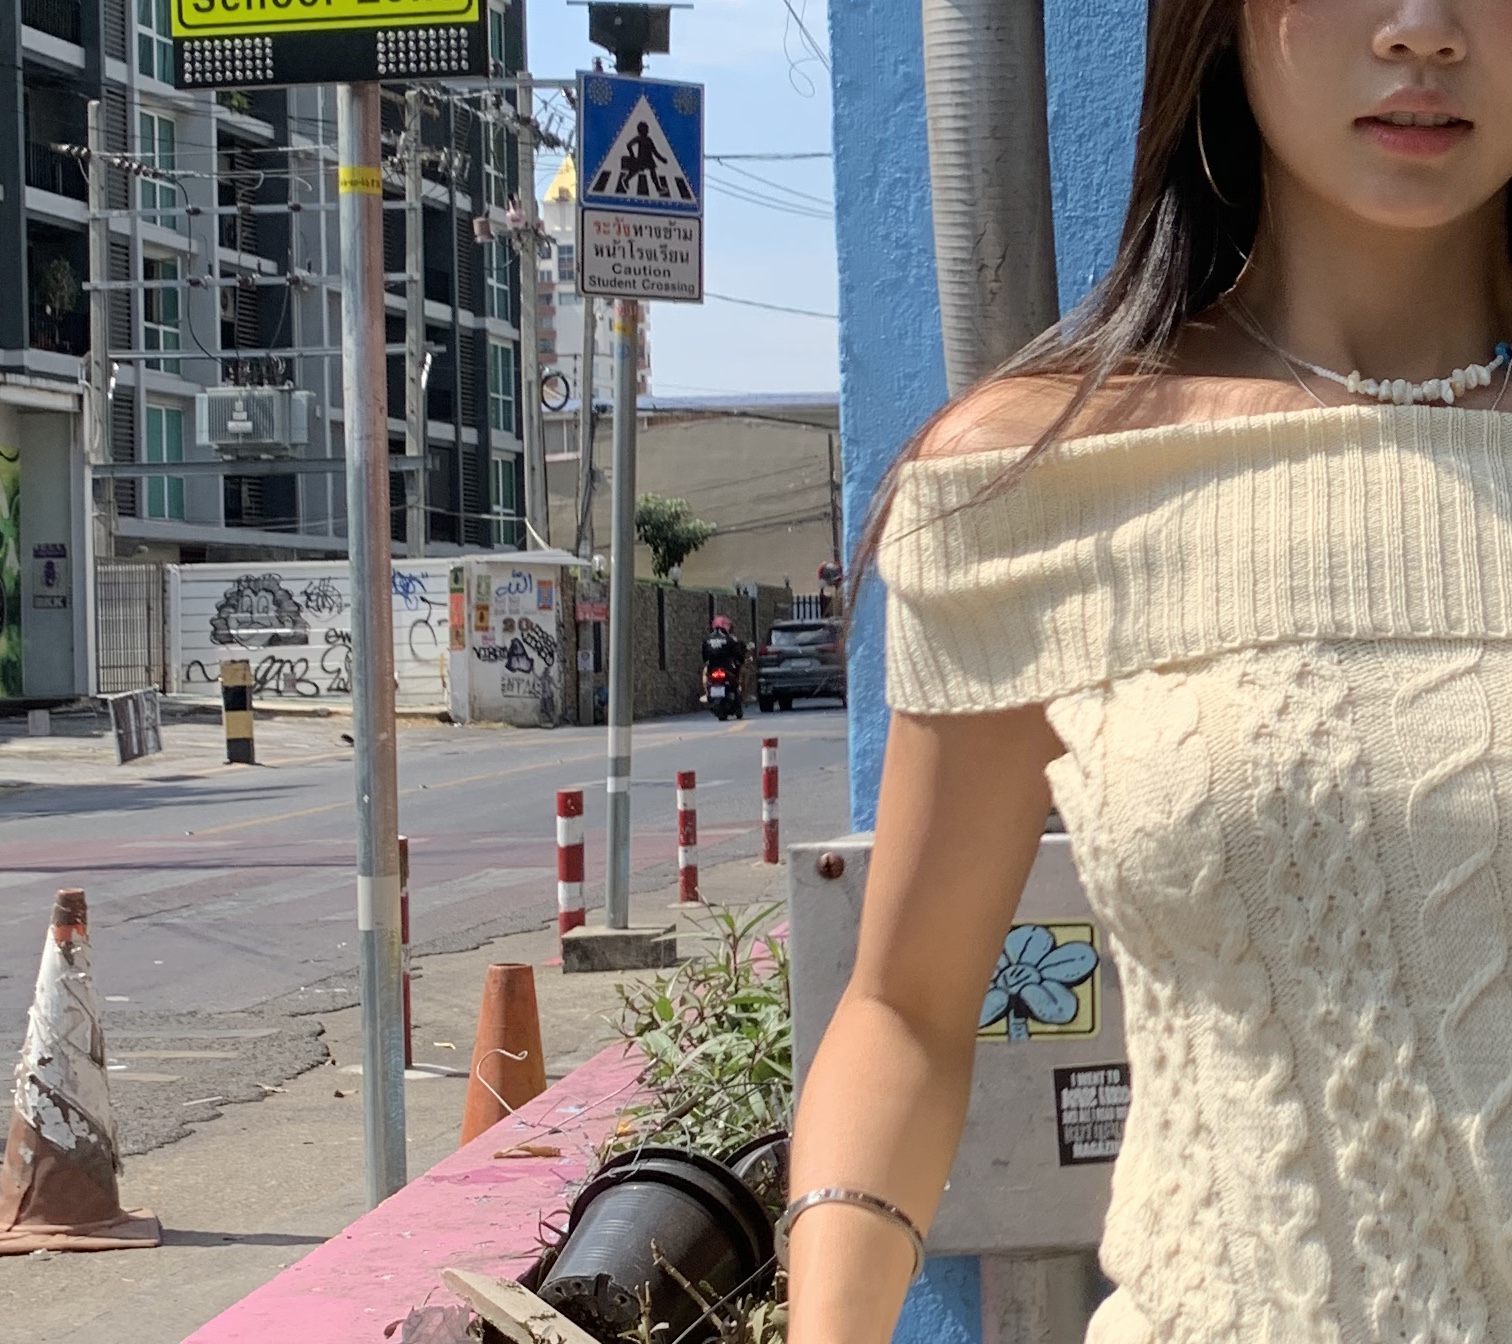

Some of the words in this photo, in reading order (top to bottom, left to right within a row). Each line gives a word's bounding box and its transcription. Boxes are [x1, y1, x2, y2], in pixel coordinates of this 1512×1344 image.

[594, 217, 692, 242] ระวังทางข้าม
[594, 239, 690, 264] หน้าโรงเรียน
[612, 263, 671, 279] Caution
[588, 274, 637, 291] Student
[642, 279, 695, 295] Crossing
